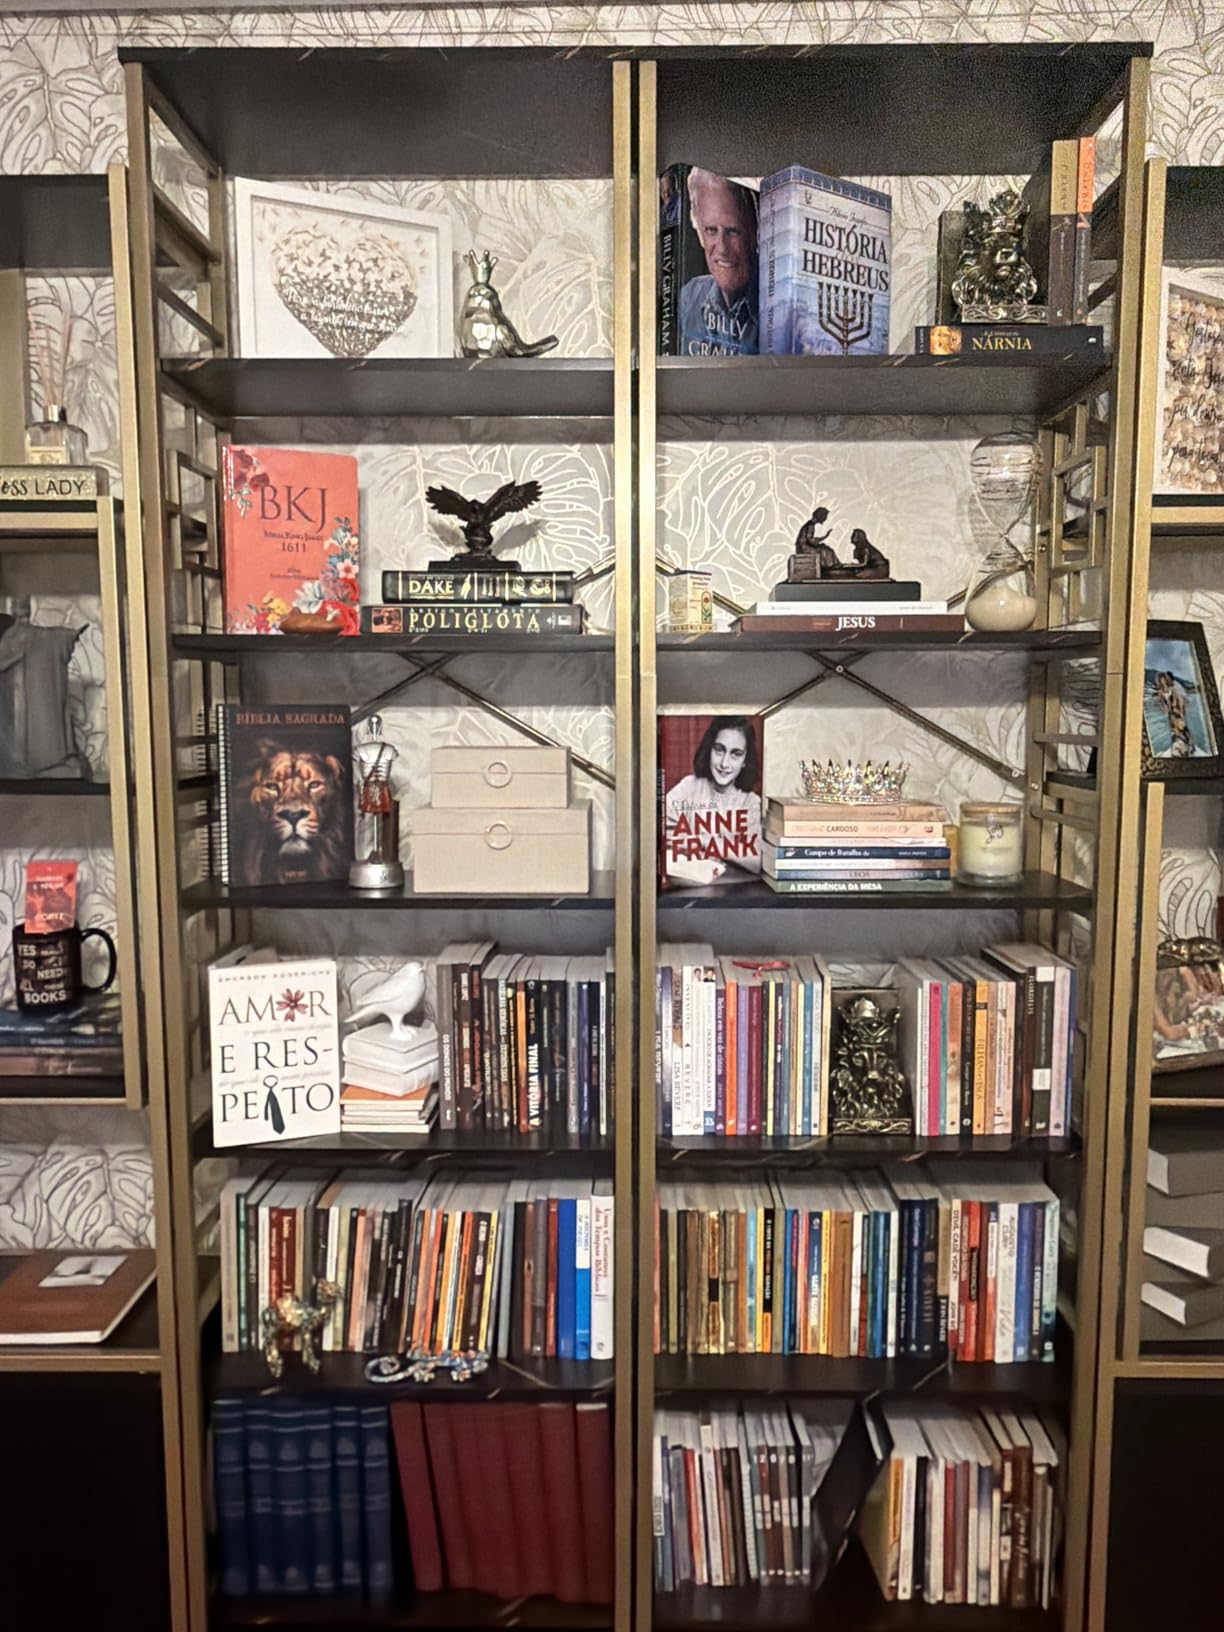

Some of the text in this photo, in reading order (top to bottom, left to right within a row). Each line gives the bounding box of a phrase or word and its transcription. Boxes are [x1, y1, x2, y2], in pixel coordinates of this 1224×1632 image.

[804, 217, 888, 265] HISTÓRIA
[802, 248, 889, 292] HEBREUS
[662, 233, 674, 346] BILLY GRAHAM
[707, 311, 748, 341] BILLY
[971, 334, 1033, 351] NÁRNIA
[35, 479, 85, 496] LADY
[259, 485, 328, 533] BKJ
[282, 542, 306, 553] 1611
[409, 580, 454, 594] DAKE
[409, 612, 540, 629] POLIGLOTA
[836, 617, 876, 631] JESUS
[285, 713, 345, 724] SAGRADA
[673, 809, 749, 837] ANNE
[671, 834, 758, 863] FRANK
[804, 849, 828, 858] Campo
[797, 882, 846, 891] EXPERIÊNCIA
[17, 944, 36, 956] YES
[37, 968, 63, 980] NEED
[24, 989, 67, 1005] BOOKS
[218, 989, 333, 1026] AMR
[718, 1020, 724, 1031] em
[220, 1036, 333, 1074] E RES-
[528, 1043, 539, 1073] FINAL
[717, 1045, 724, 1054] de
[527, 1076, 539, 1116] VITÓRIA
[529, 1117, 541, 1126] A
[593, 1225, 602, 1257] Tempos
